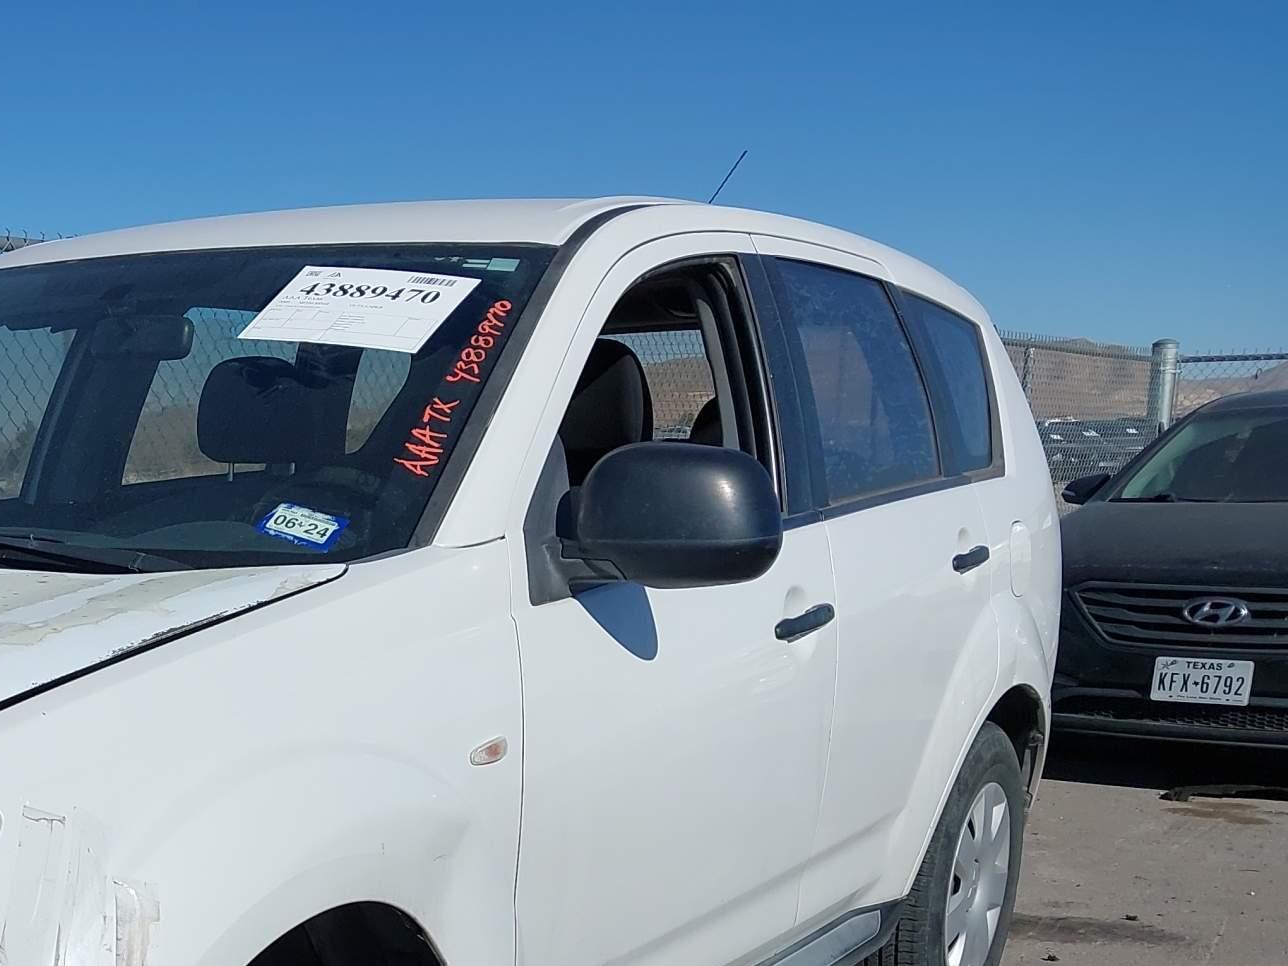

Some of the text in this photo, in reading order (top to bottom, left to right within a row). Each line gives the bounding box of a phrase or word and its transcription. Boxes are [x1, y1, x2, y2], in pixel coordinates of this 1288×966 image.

[299, 281, 441, 305] 43889470
[273, 514, 299, 529] 06
[304, 523, 329, 539] 24
[1186, 660, 1223, 671] TEXAS
